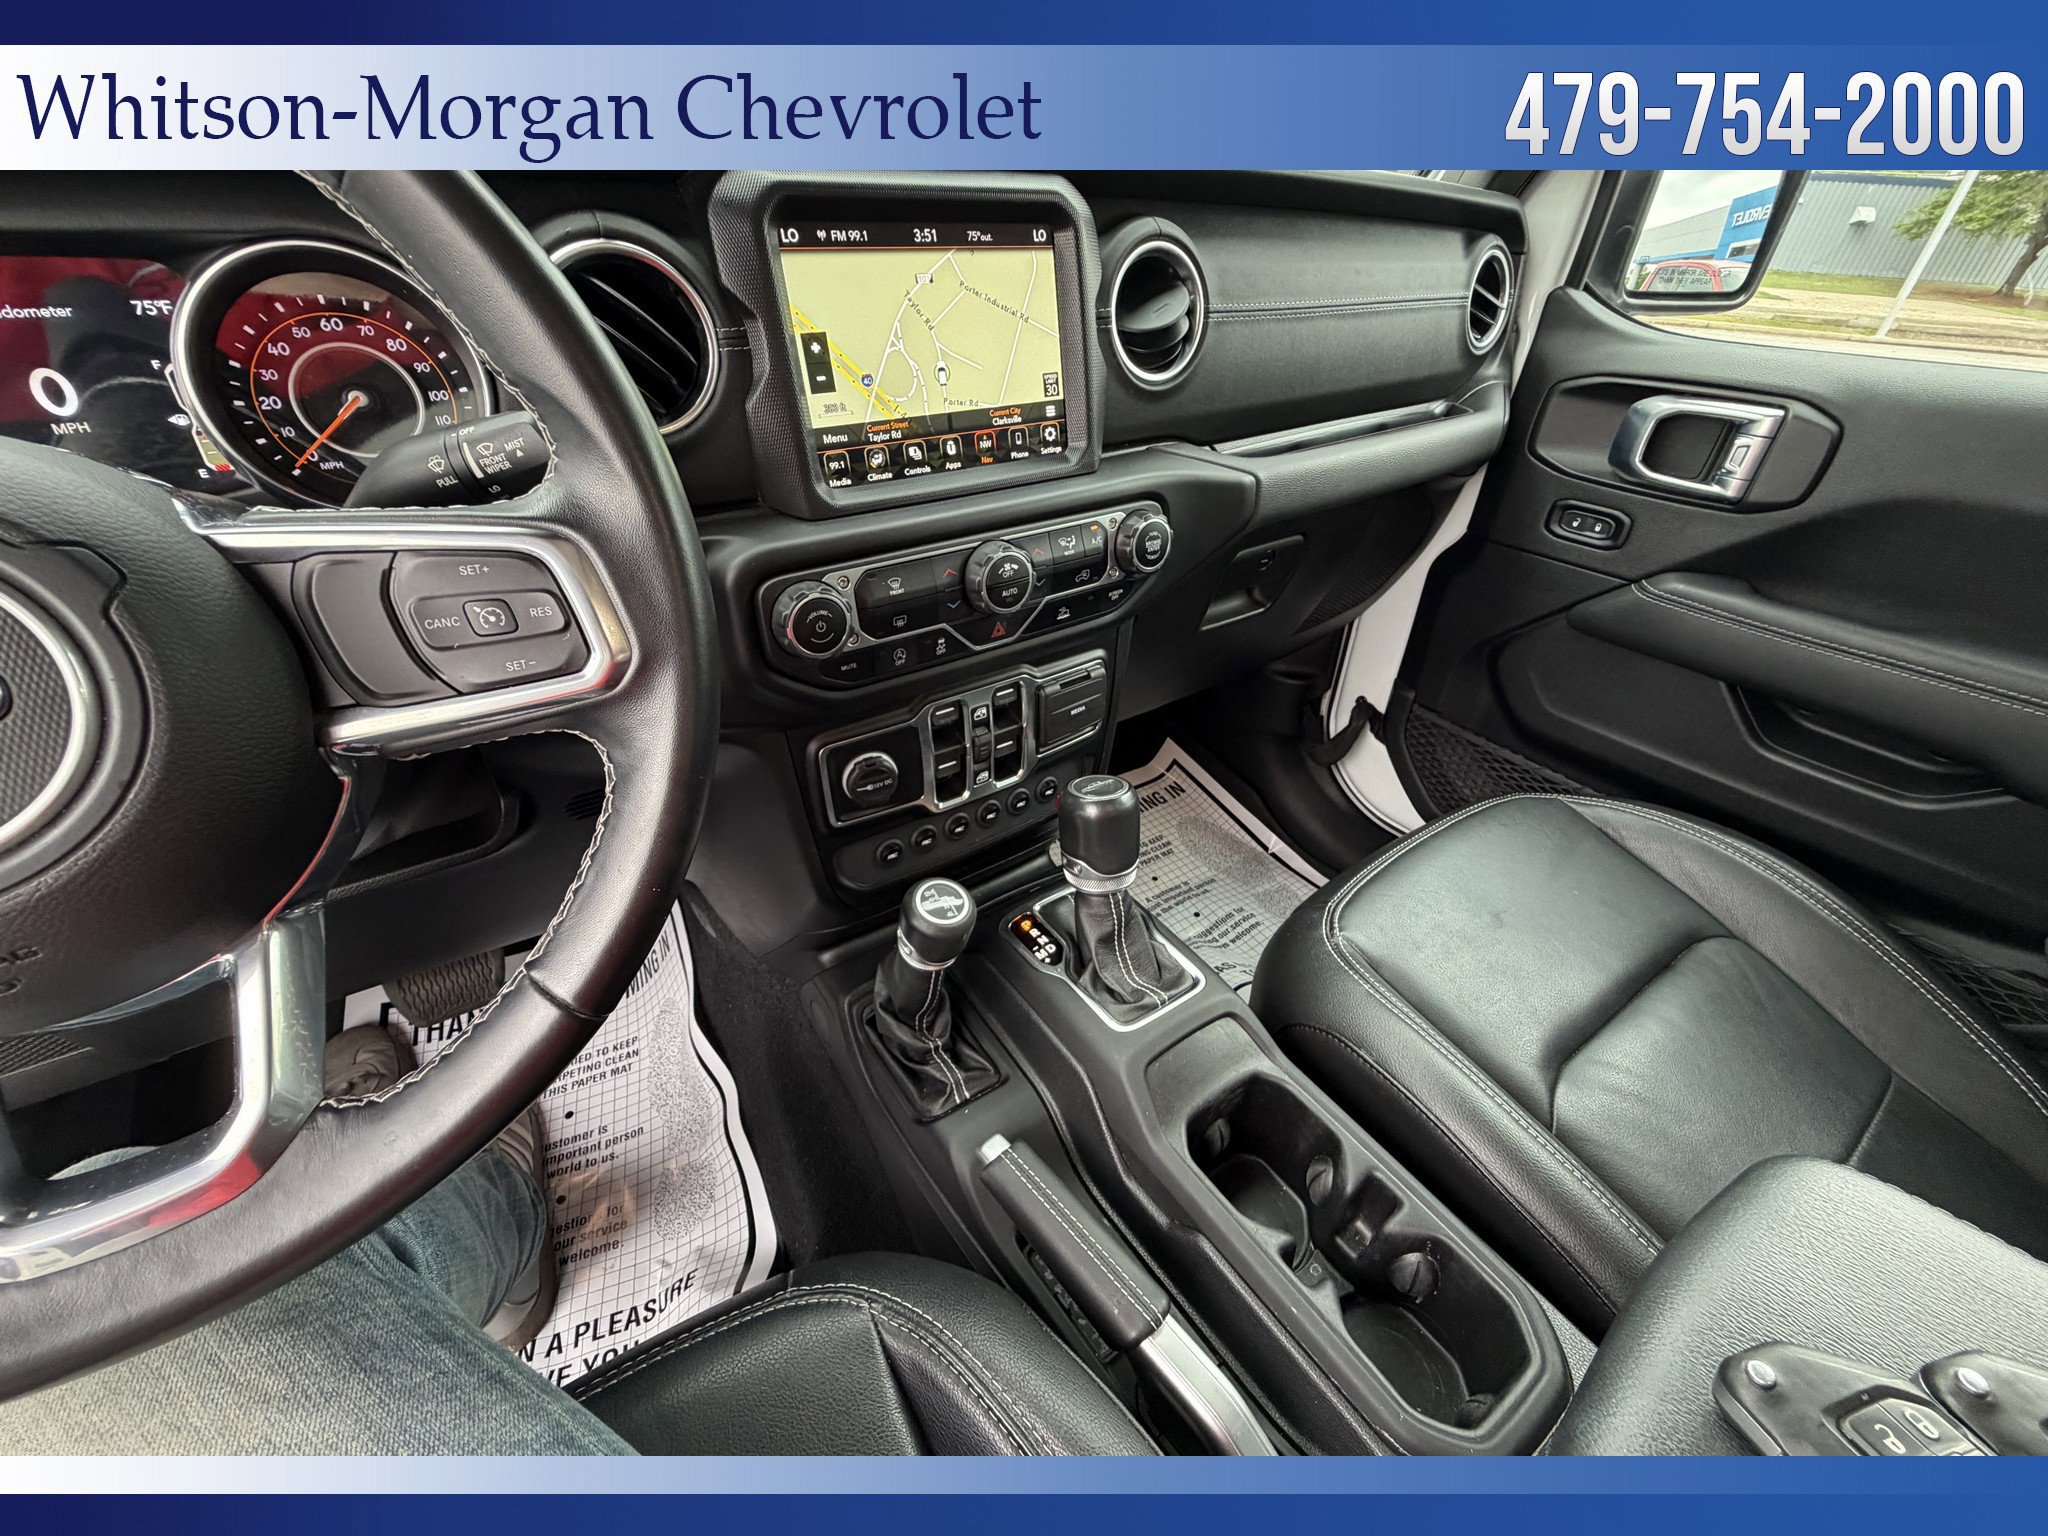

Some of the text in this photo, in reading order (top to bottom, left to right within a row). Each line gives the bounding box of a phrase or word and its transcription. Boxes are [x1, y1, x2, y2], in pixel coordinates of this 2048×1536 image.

[780, 228, 799, 243] LO
[831, 230, 868, 242] FM 99.1
[913, 228, 937, 242] 3:51
[1033, 229, 1047, 242] LO
[959, 280, 1029, 323] Porter Industrial Rd
[904, 290, 935, 331] Taylor Rd
[319, 317, 344, 331] 60
[291, 326, 311, 338] 50
[356, 325, 375, 336] 70
[267, 342, 290, 356] 40
[386, 338, 407, 352] 80
[151, 359, 162, 370] F
[413, 362, 430, 373] 90
[259, 368, 278, 381] 30
[29, 367, 79, 417] 0
[428, 390, 449, 401] 100
[1045, 384, 1058, 396] 30
[258, 396, 282, 410] 20
[943, 398, 979, 407] Porter Rd
[435, 415, 451, 426] 110
[992, 415, 1022, 426] Clarksville
[51, 421, 92, 435] MPH
[280, 426, 295, 437] 10
[458, 426, 475, 436] OFF
[822, 434, 848, 444] Menu
[868, 430, 902, 443] Taylor Rd
[504, 437, 525, 452] MIST
[1040, 445, 1062, 455] Settings
[478, 453, 507, 467] FRONT
[981, 456, 993, 464] Nav
[1010, 451, 1029, 459] Phone
[320, 461, 344, 470] MPH
[483, 461, 512, 475] WIPER
[829, 461, 845, 470] 99.1
[904, 465, 931, 475] Controls
[945, 460, 962, 470] Apps
[198, 468, 210, 478] E
[867, 472, 893, 481] Climate
[435, 475, 459, 488] PULL
[829, 478, 852, 487] Media
[488, 485, 501, 493] LO
[1002, 570, 1015, 579] OFF
[1001, 588, 1018, 598] AUTO
[529, 606, 553, 618] RES
[424, 616, 461, 630] CANC
[841, 662, 857, 671] MUTE
[1139, 781, 1186, 813] ING IN
[659, 929, 670, 962] IN
[1045, 943, 1056, 953] D
[596, 1047, 609, 1057] TO
[612, 1036, 638, 1053] KEEP
[557, 1048, 639, 1082] PETING CLEAN
[543, 1062, 634, 1099] THIS PAPER MAT
[597, 1125, 608, 1136] is
[605, 1126, 644, 1150] person
[546, 1152, 620, 1180] world to us.
[553, 1219, 628, 1252] our service
[544, 1333, 563, 1358] A
[573, 1268, 699, 1349] PLEASURE
